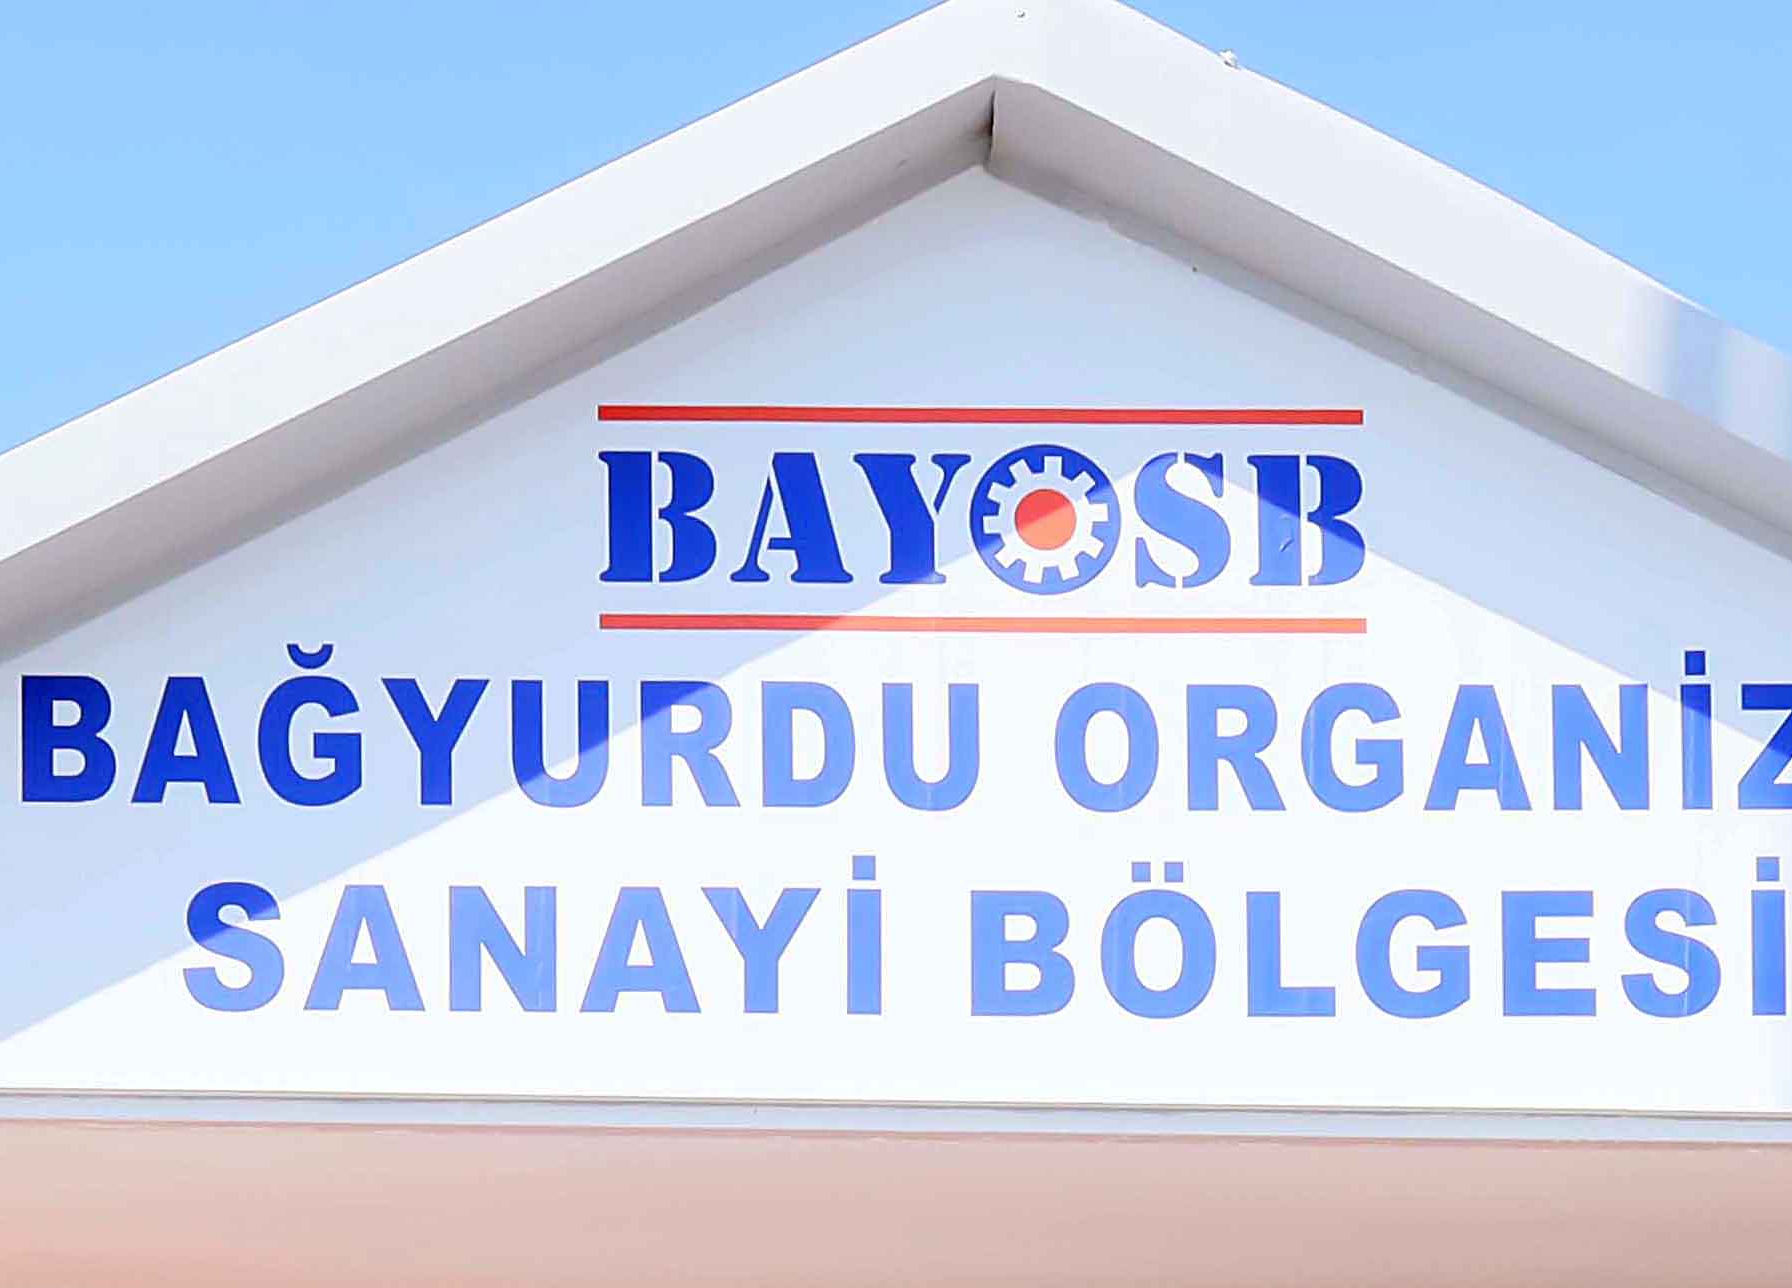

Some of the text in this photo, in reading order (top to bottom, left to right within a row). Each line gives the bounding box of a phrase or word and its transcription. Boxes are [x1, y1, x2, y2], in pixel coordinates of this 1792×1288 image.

[598, 443, 1367, 595] BAYOSB
[22, 643, 979, 811] BAĞYURDU
[185, 856, 1787, 1019] SANAYİ BÖLGESİ
